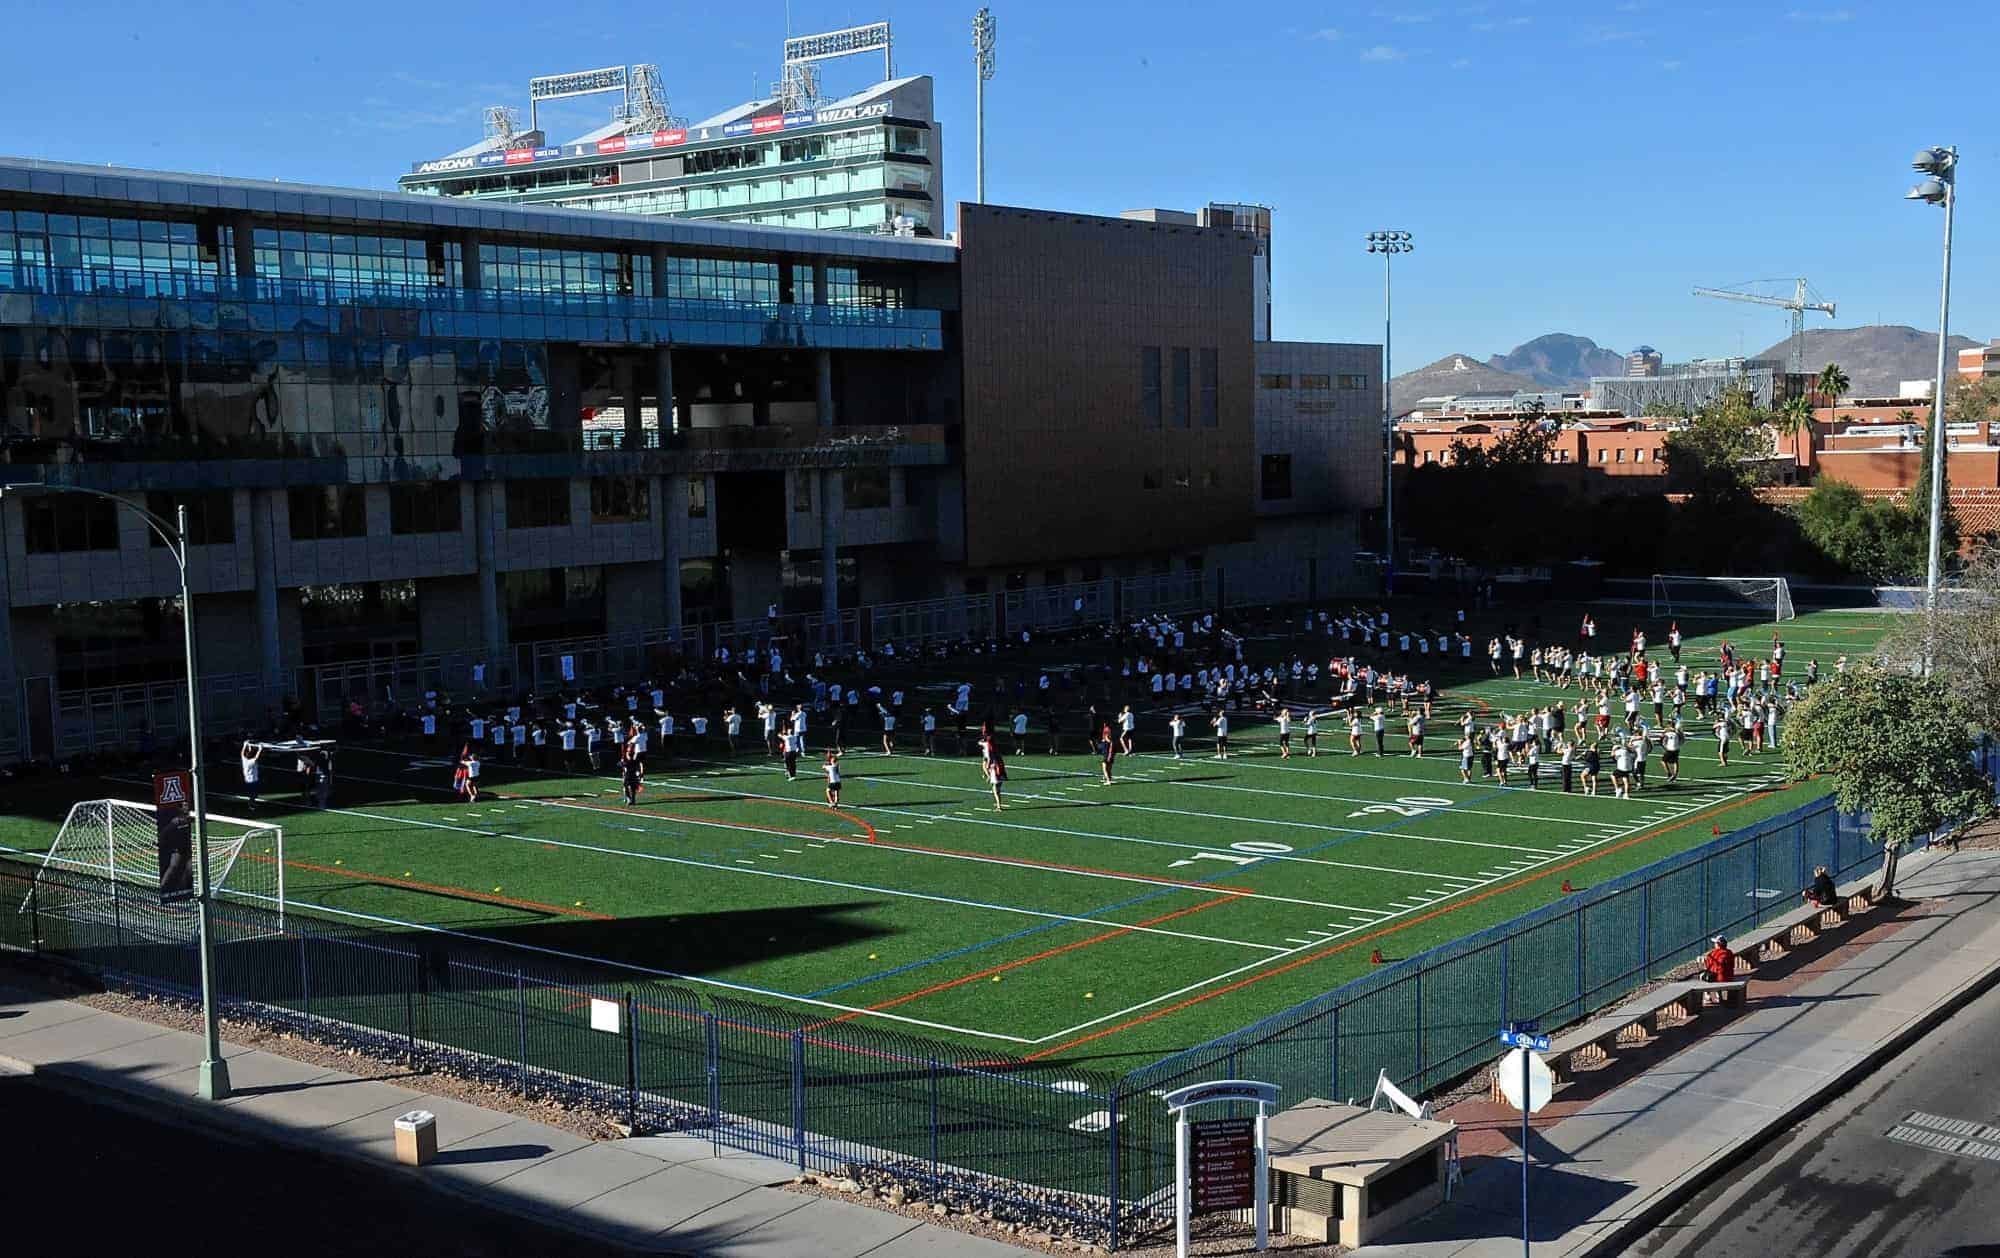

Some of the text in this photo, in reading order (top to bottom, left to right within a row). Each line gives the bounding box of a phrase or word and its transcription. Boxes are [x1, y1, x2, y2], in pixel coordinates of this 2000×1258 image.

[815, 102, 889, 124] WILDCATS
[418, 157, 475, 173] ARIZONA
[160, 776, 185, 804] A
[1361, 796, 1454, 817] 20
[1191, 841, 1294, 866] 10
